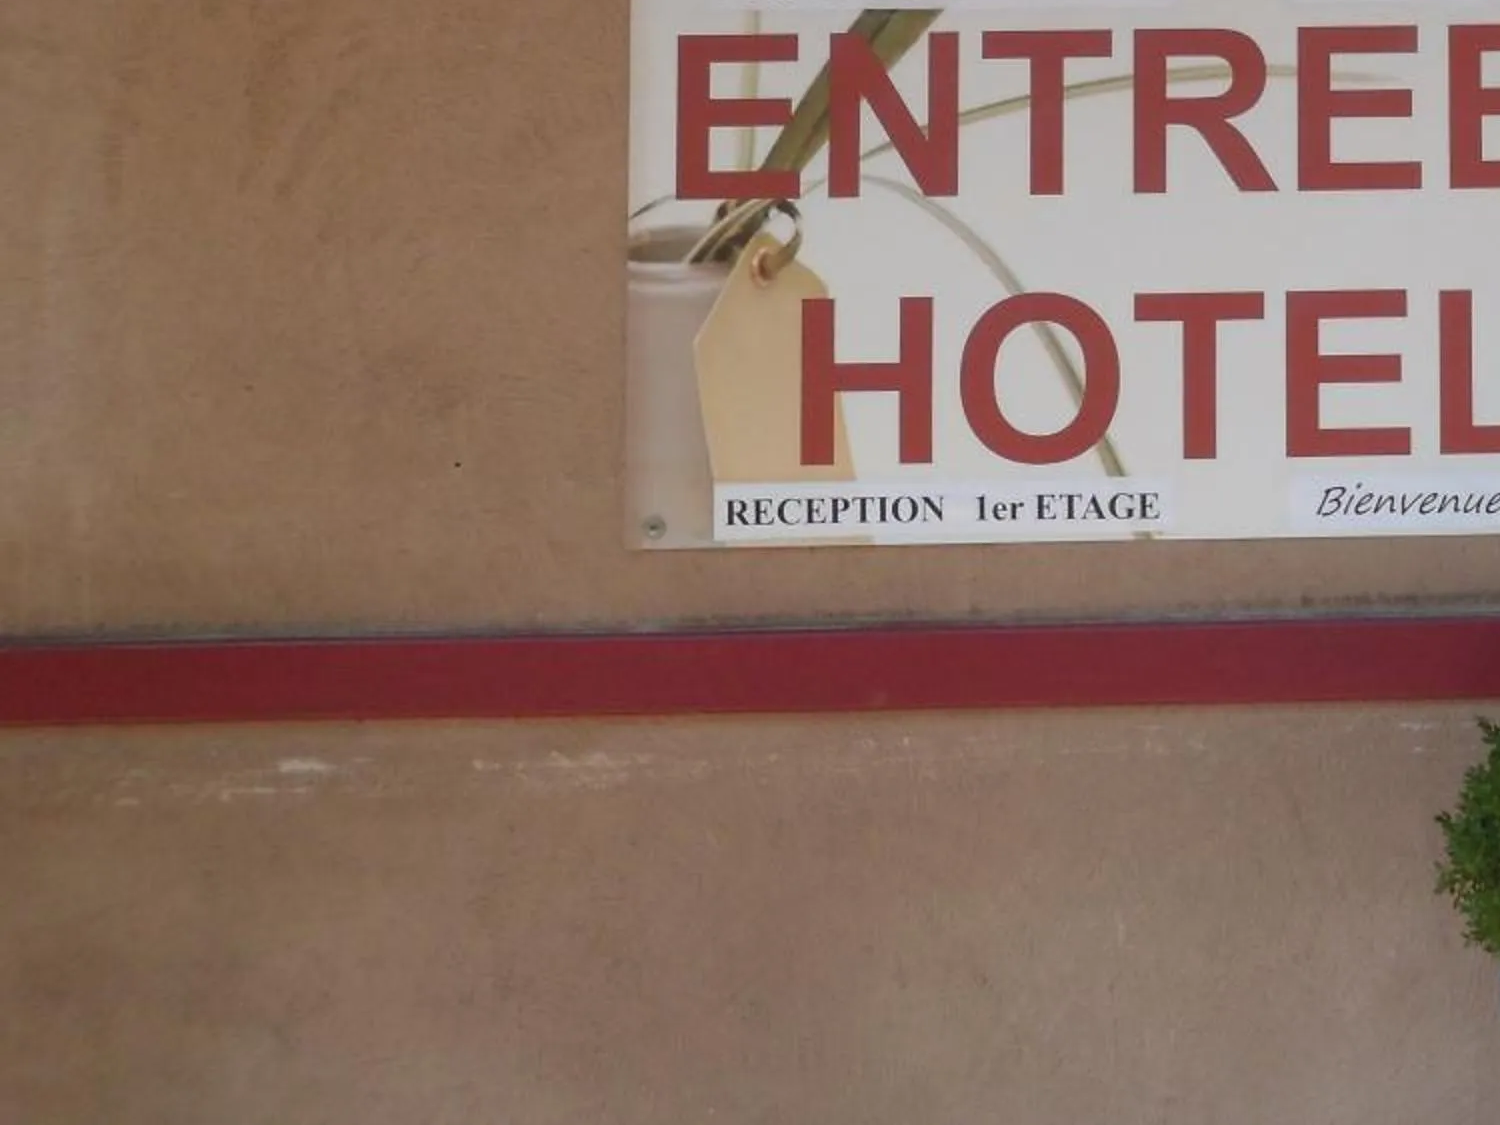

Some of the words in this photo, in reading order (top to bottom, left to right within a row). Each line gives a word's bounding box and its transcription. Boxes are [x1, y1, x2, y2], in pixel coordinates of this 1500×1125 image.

[726, 495, 945, 526] RECEPTION
[976, 495, 1025, 522] 1er
[1036, 492, 1160, 521] ETAGE
